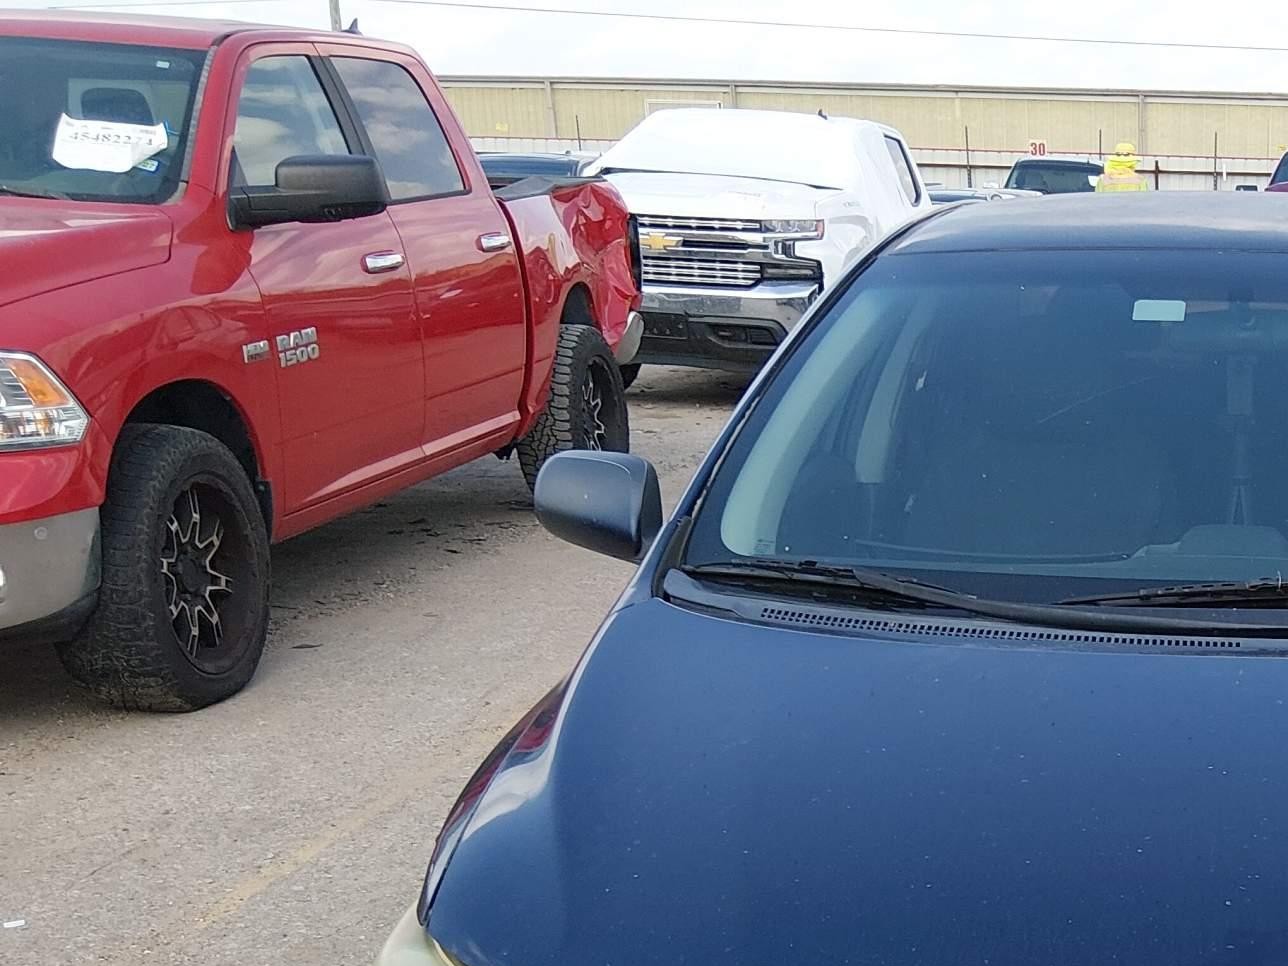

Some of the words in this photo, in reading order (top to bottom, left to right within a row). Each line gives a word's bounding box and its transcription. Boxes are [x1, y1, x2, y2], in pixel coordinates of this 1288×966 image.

[1030, 142, 1046, 156] 30
[275, 326, 318, 351] RAM
[279, 343, 320, 368] 1500
